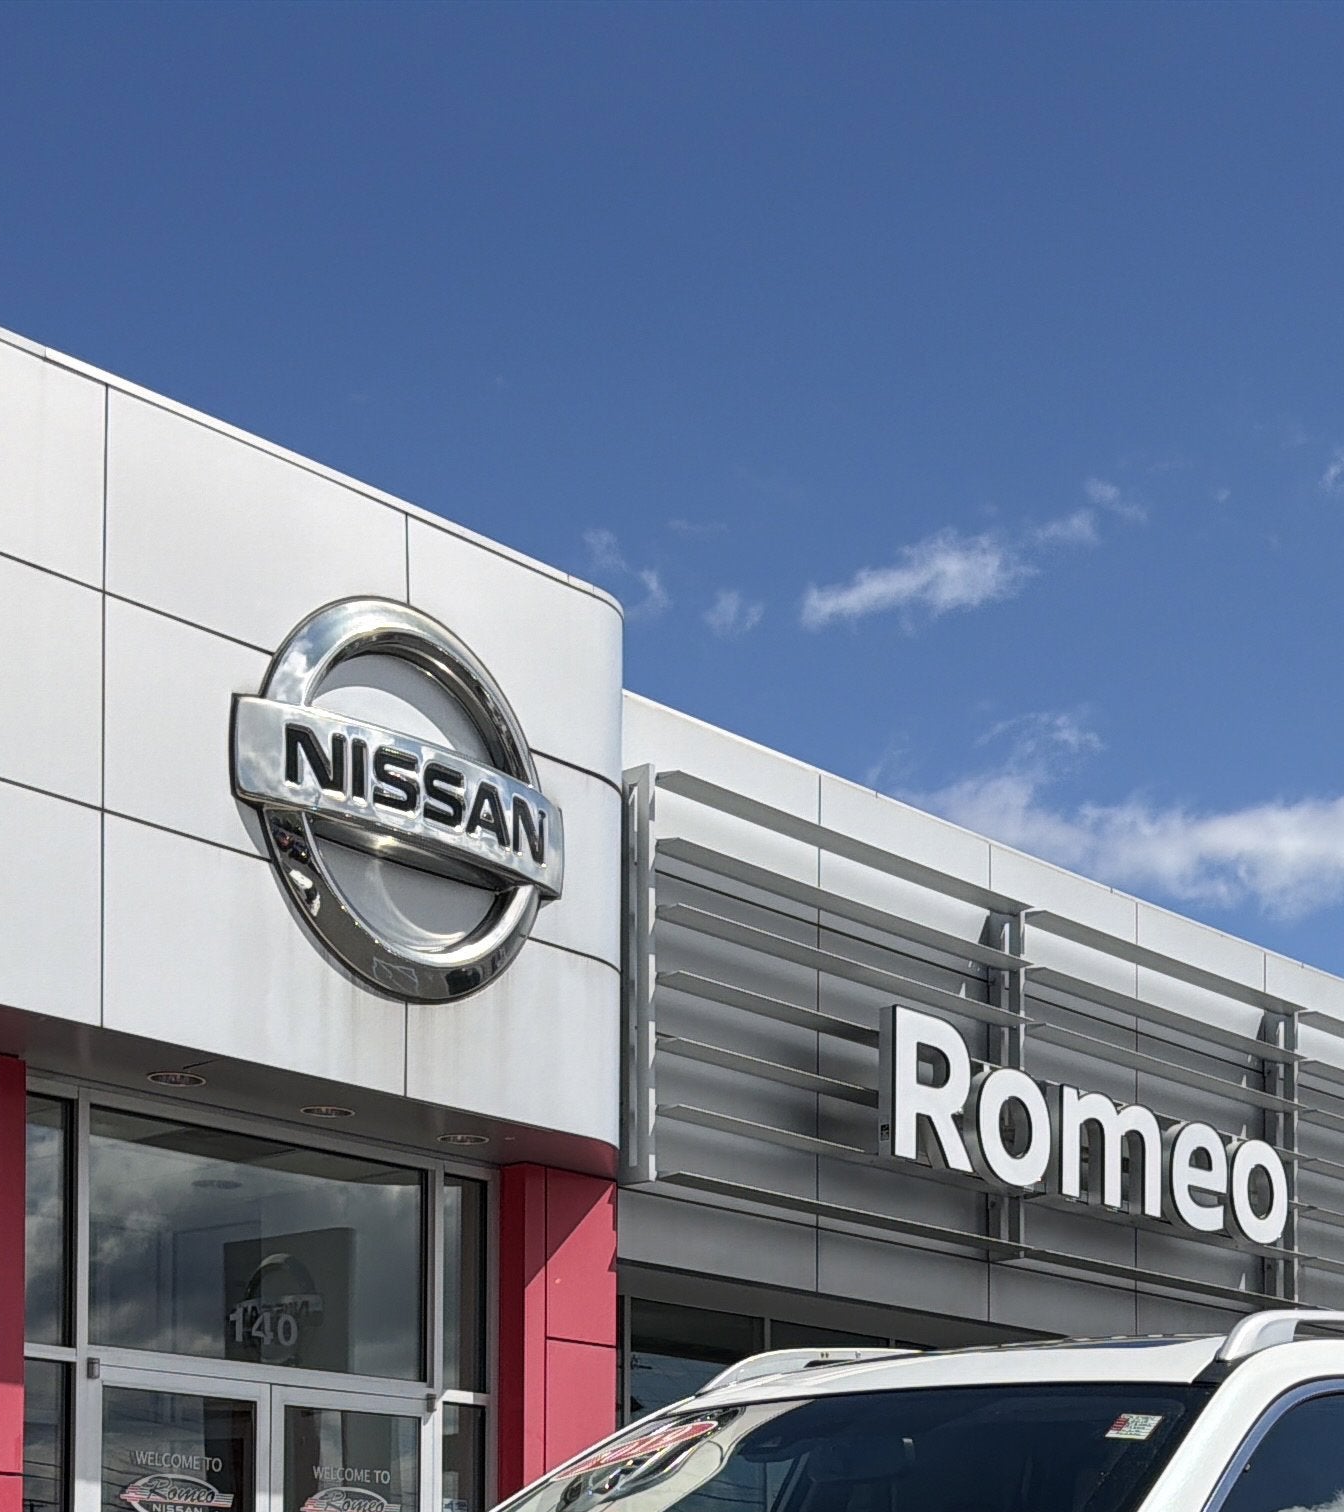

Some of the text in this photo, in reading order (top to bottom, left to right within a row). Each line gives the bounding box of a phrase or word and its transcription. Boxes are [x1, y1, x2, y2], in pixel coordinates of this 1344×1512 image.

[284, 723, 547, 866] NISSAN
[890, 1004, 1288, 1244] Romeo
[229, 1304, 298, 1346] 140
[135, 1450, 223, 1473] WELCOME TO
[313, 1466, 391, 1485] WELCOME TO
[142, 1475, 216, 1503] Romeo
